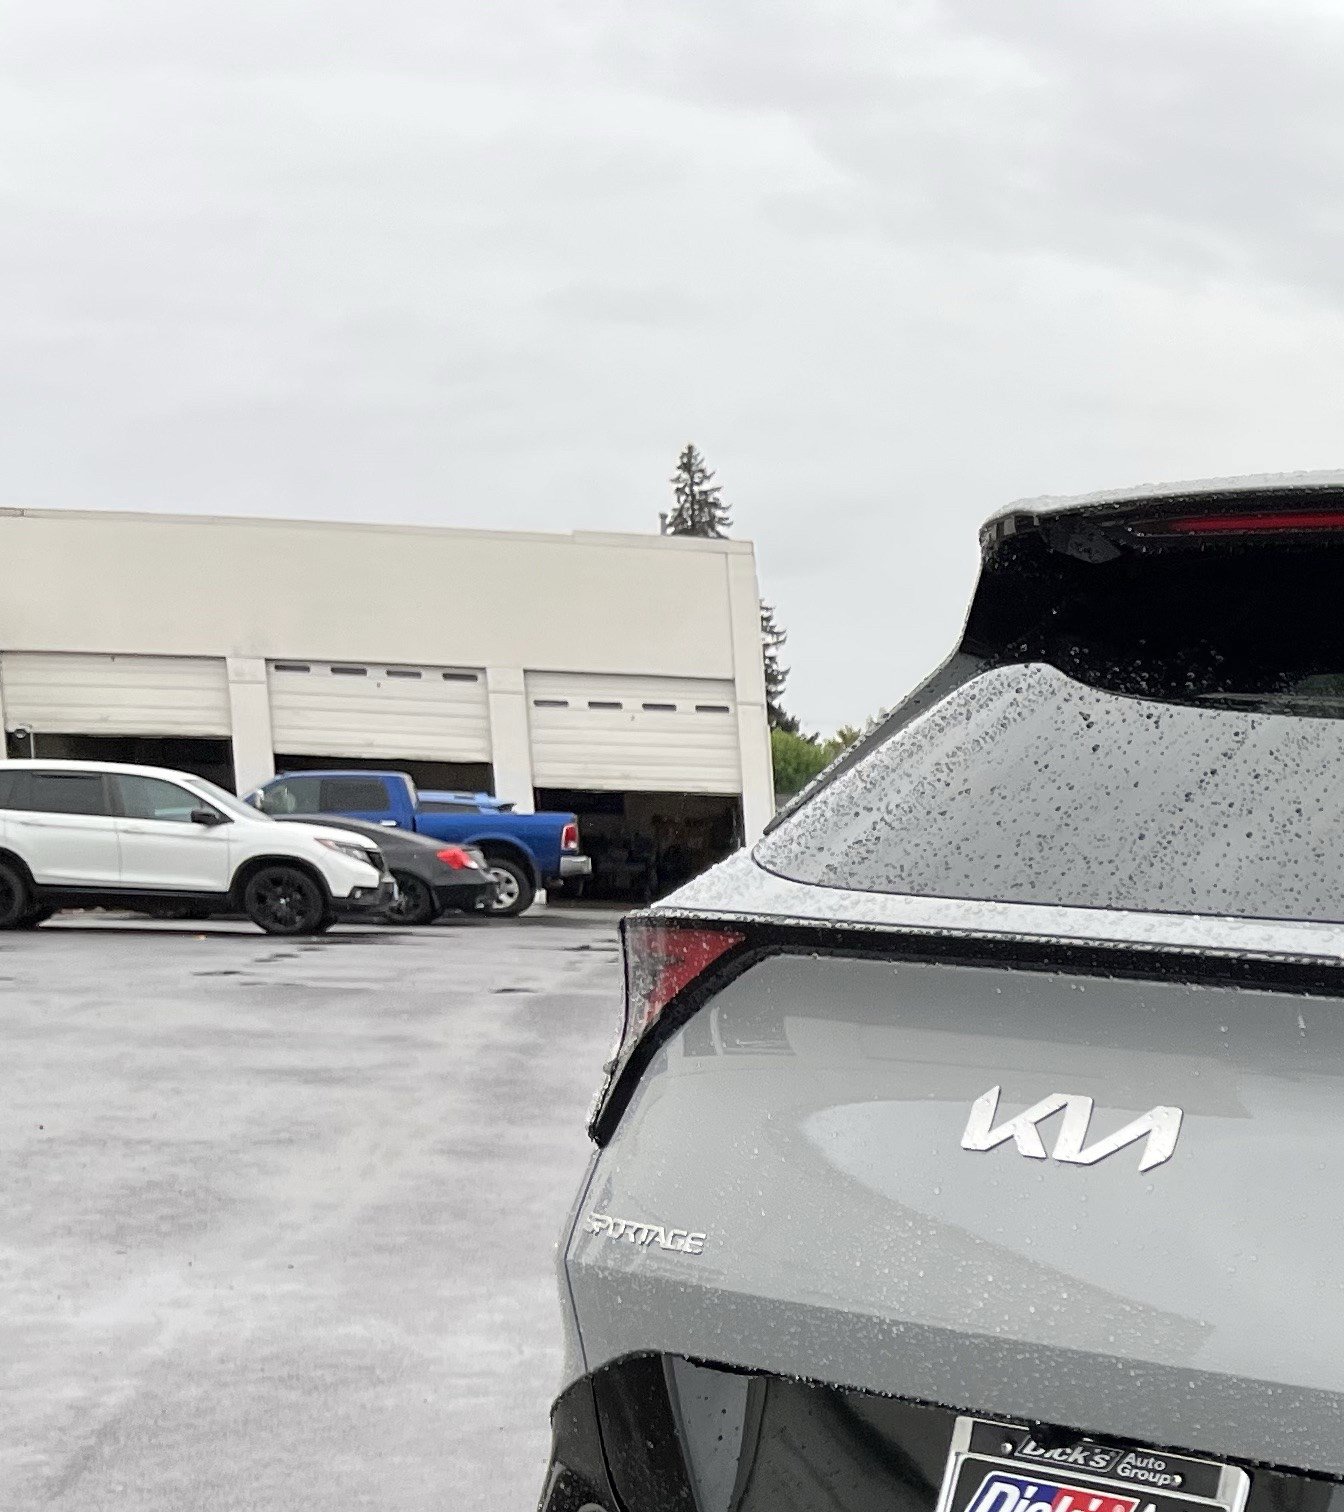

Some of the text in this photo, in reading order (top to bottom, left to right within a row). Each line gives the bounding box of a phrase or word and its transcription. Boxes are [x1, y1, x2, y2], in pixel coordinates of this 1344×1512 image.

[960, 1085, 1183, 1173] KIA
[1122, 1452, 1167, 1471] Auto
[1116, 1463, 1172, 1486] Group
